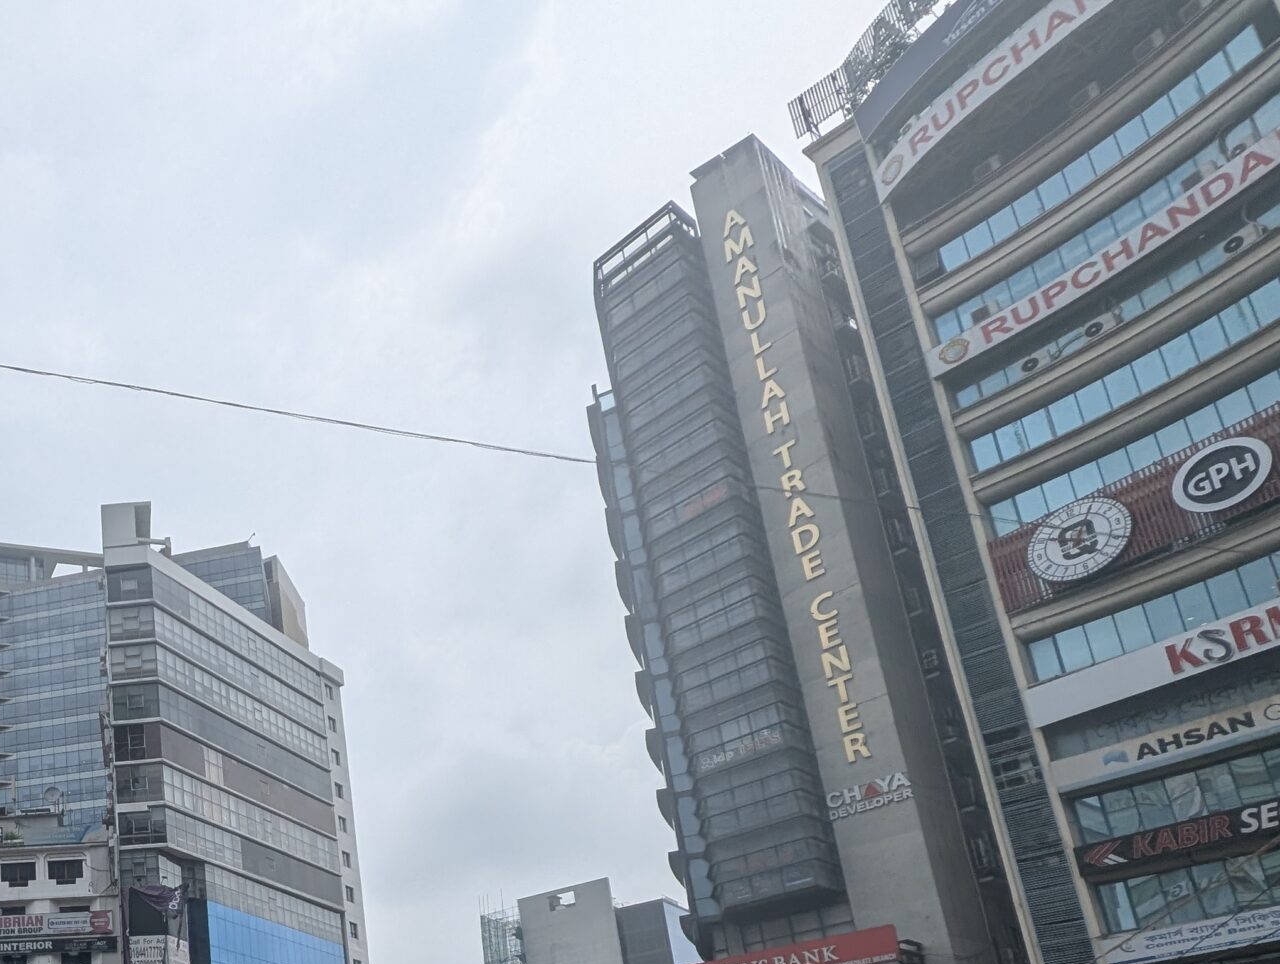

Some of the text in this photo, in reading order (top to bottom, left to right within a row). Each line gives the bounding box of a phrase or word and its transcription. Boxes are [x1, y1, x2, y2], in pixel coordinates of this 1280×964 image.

[979, 150, 1275, 344] RUPCHANDA
[723, 208, 872, 764] AMANULLAH TRADE CENTER
[1188, 452, 1258, 497] GPH
[1137, 711, 1256, 760] AHSAN
[1133, 802, 1280, 859] KABIR SE
[0, 941, 53, 953] INTERIOR
[18, 926, 44, 935] GROUP
[1145, 930, 1222, 950] Commerce
[1227, 923, 1264, 936] Bank
